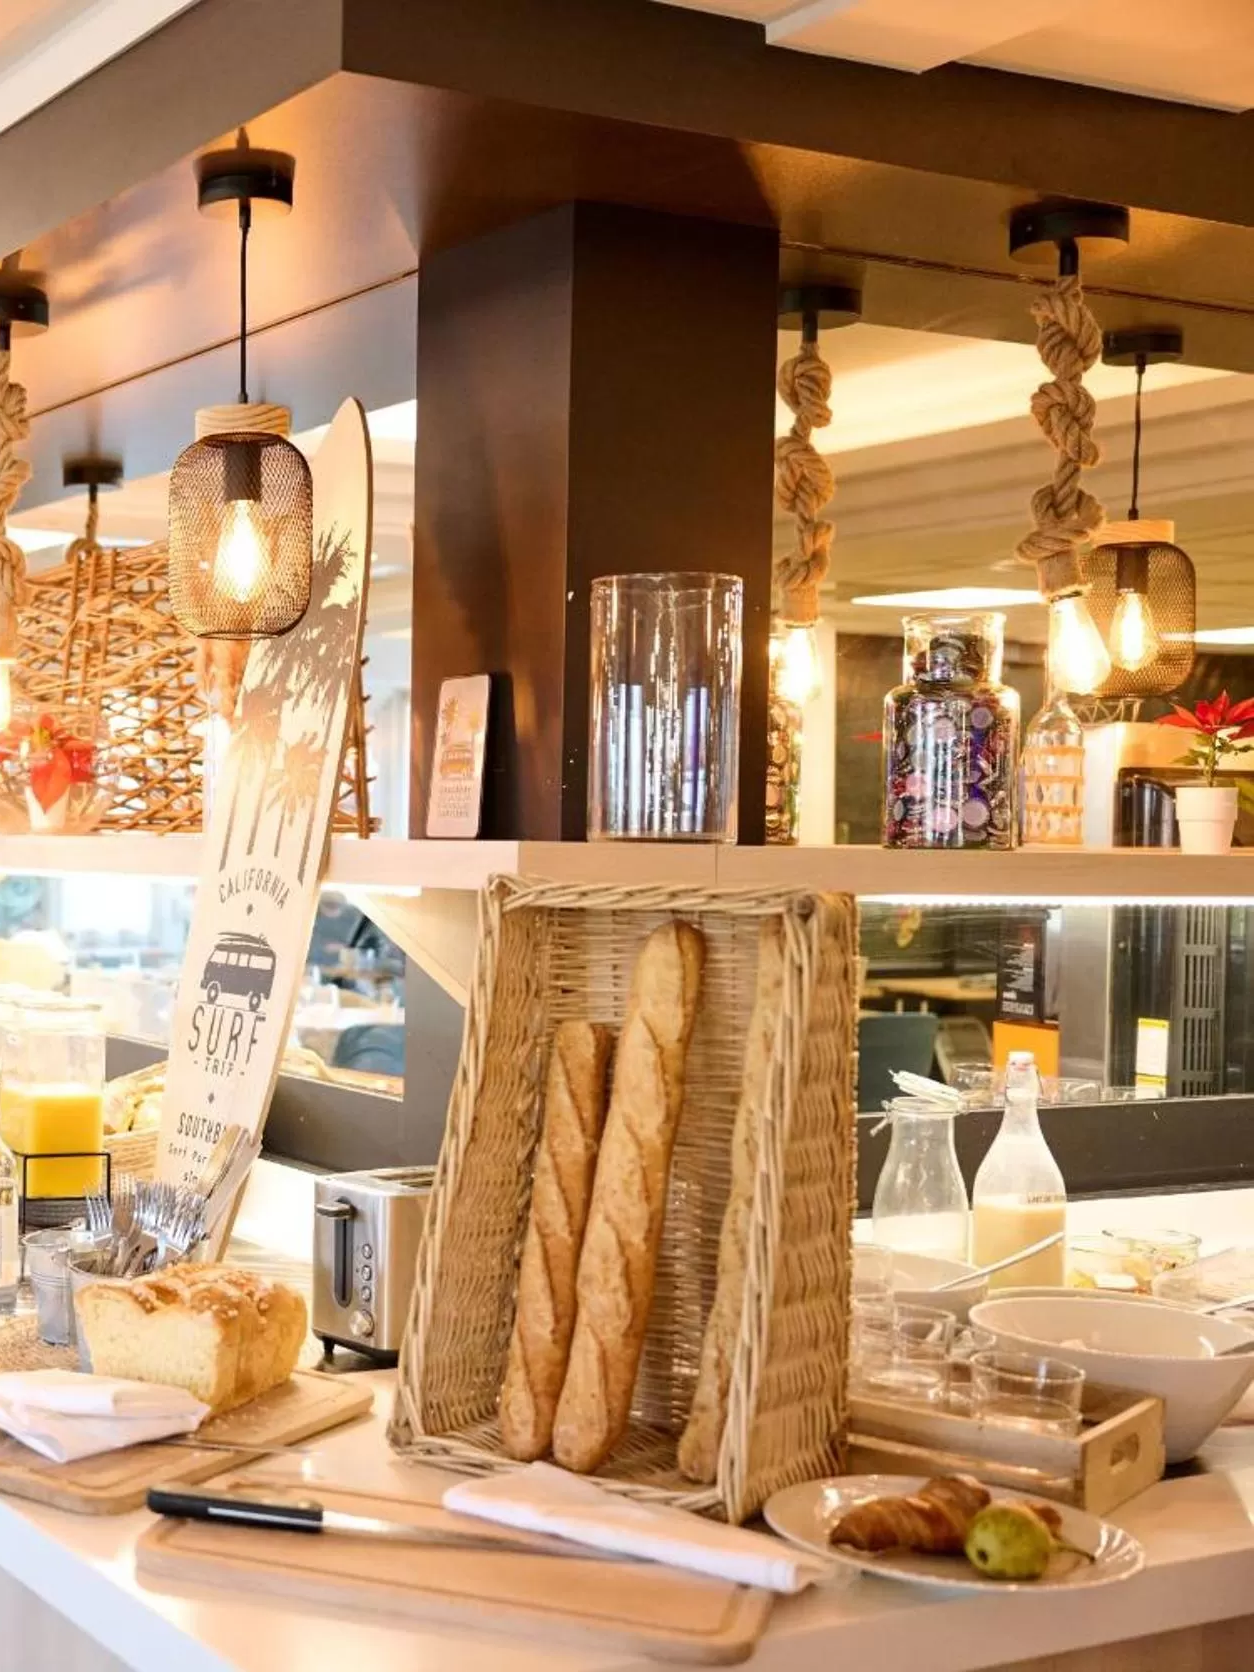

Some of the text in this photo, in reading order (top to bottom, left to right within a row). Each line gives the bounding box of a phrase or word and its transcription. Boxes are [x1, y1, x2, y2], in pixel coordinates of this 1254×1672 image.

[219, 868, 290, 909] CALIFORNIA
[188, 1004, 266, 1065] SURF
[177, 1112, 226, 1144] SOUTHB
